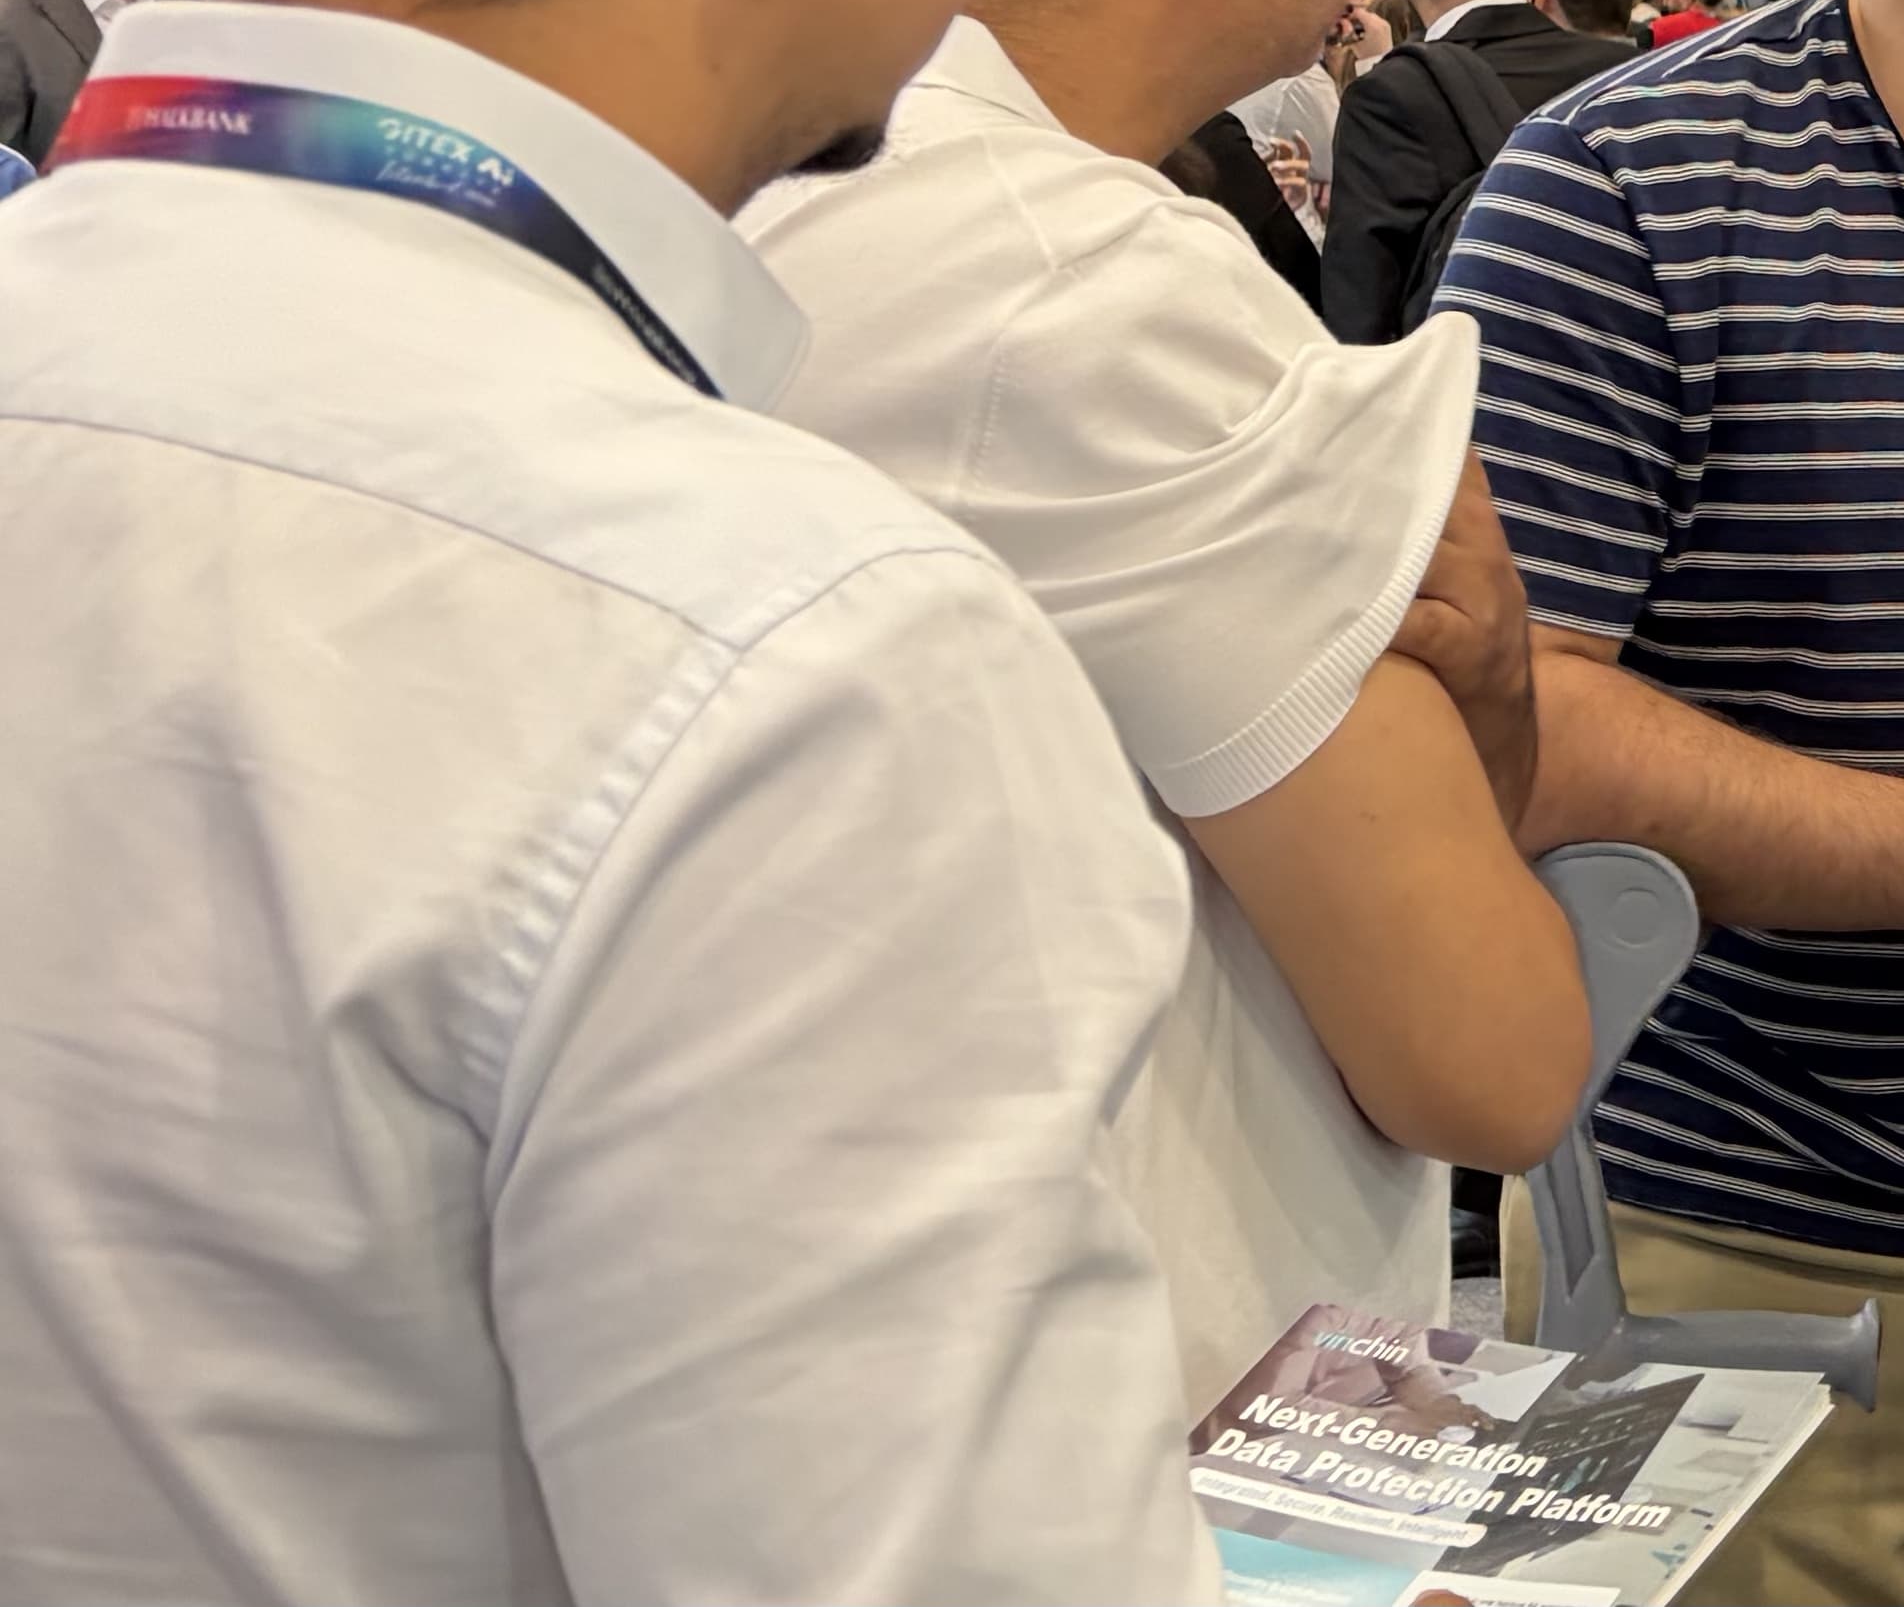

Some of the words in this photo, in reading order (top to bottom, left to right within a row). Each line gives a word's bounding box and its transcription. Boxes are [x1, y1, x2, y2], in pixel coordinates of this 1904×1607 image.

[1314, 1331, 1409, 1364] vinchin
[1239, 1394, 1548, 1477] Next-Generation
[1206, 1428, 1300, 1472] Data
[1302, 1451, 1505, 1513] Protection
[1507, 1487, 1672, 1528] Platform
